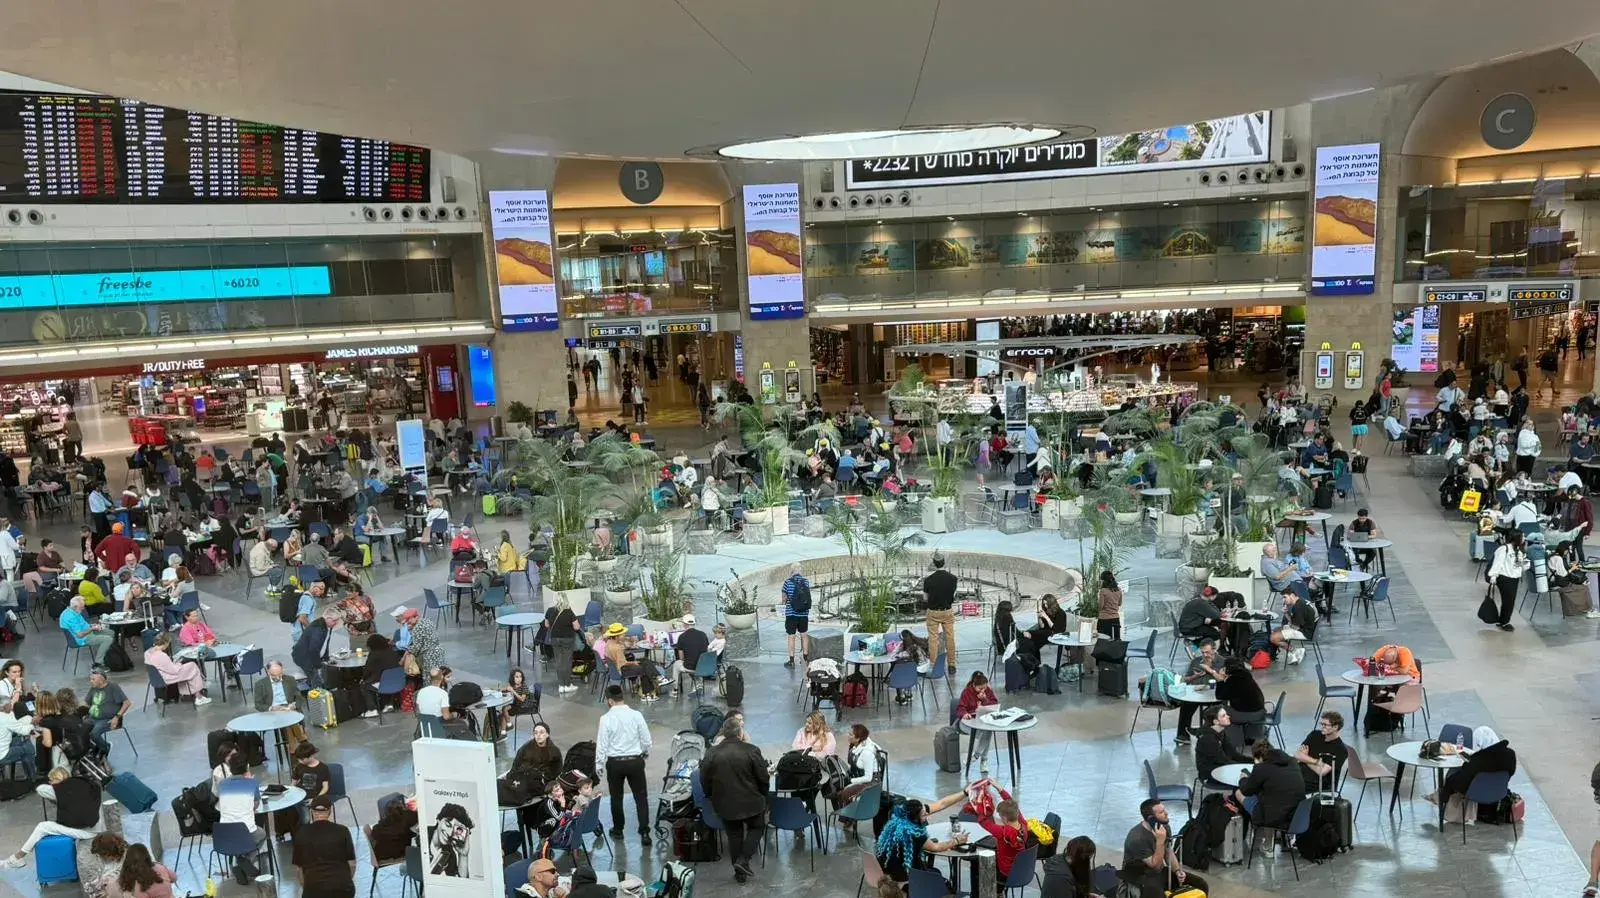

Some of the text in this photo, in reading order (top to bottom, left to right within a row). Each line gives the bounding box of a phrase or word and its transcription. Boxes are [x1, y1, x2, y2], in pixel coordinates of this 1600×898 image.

[1495, 108, 1516, 134] C
[978, 146, 1018, 169] יוקרה
[1025, 142, 1085, 162] מגדירים
[634, 169, 650, 191] B
[97, 276, 153, 293] freesbe
[326, 344, 418, 359] JAMES RICHARDSON
[182, 358, 205, 370] FREE
[433, 789, 453, 797] Galaxy
